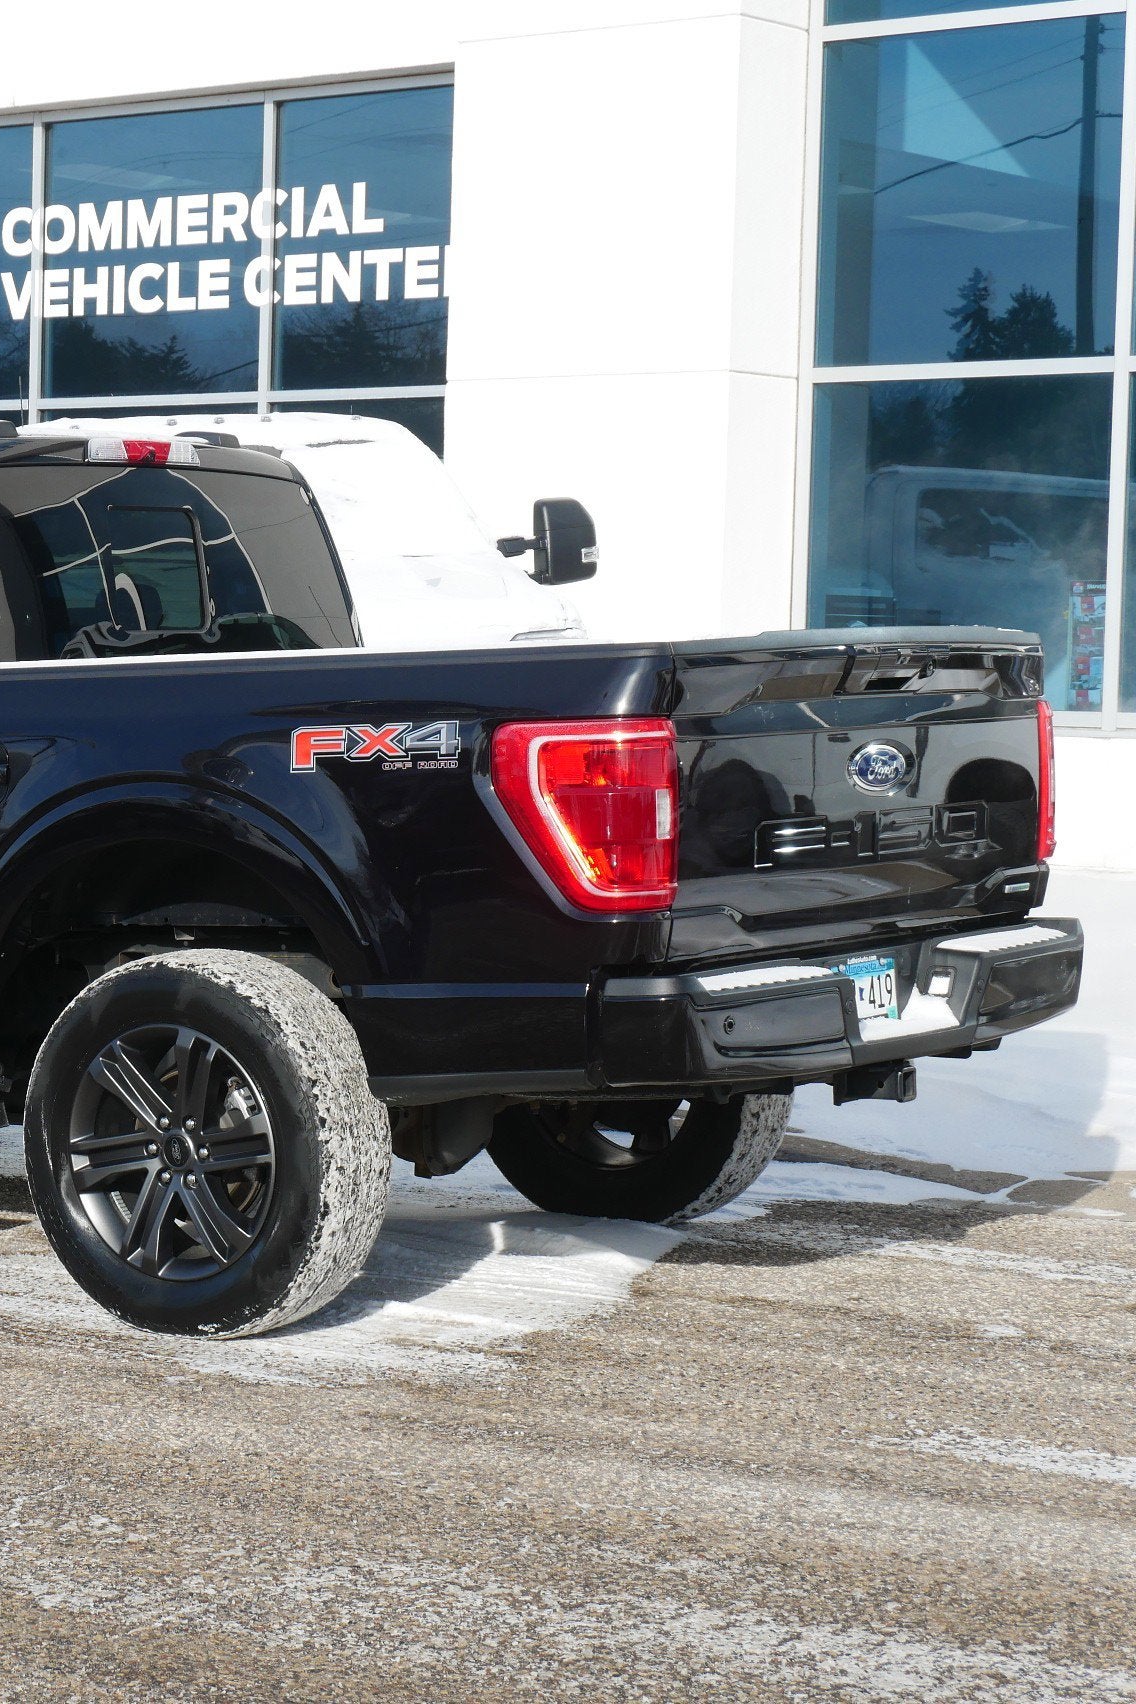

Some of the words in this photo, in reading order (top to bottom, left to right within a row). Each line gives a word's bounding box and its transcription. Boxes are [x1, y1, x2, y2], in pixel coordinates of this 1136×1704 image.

[1, 181, 384, 257] COMMERCIAL
[1, 258, 231, 320] VEHICLE
[243, 244, 451, 307] CENTE
[290, 720, 460, 773] FX4
[381, 761, 413, 771] OFF
[417, 760, 459, 769] ROAD
[867, 754, 897, 780] Ford
[754, 800, 989, 868] F-150
[845, 963, 877, 975] Minnesota
[868, 973, 893, 1010] 419
